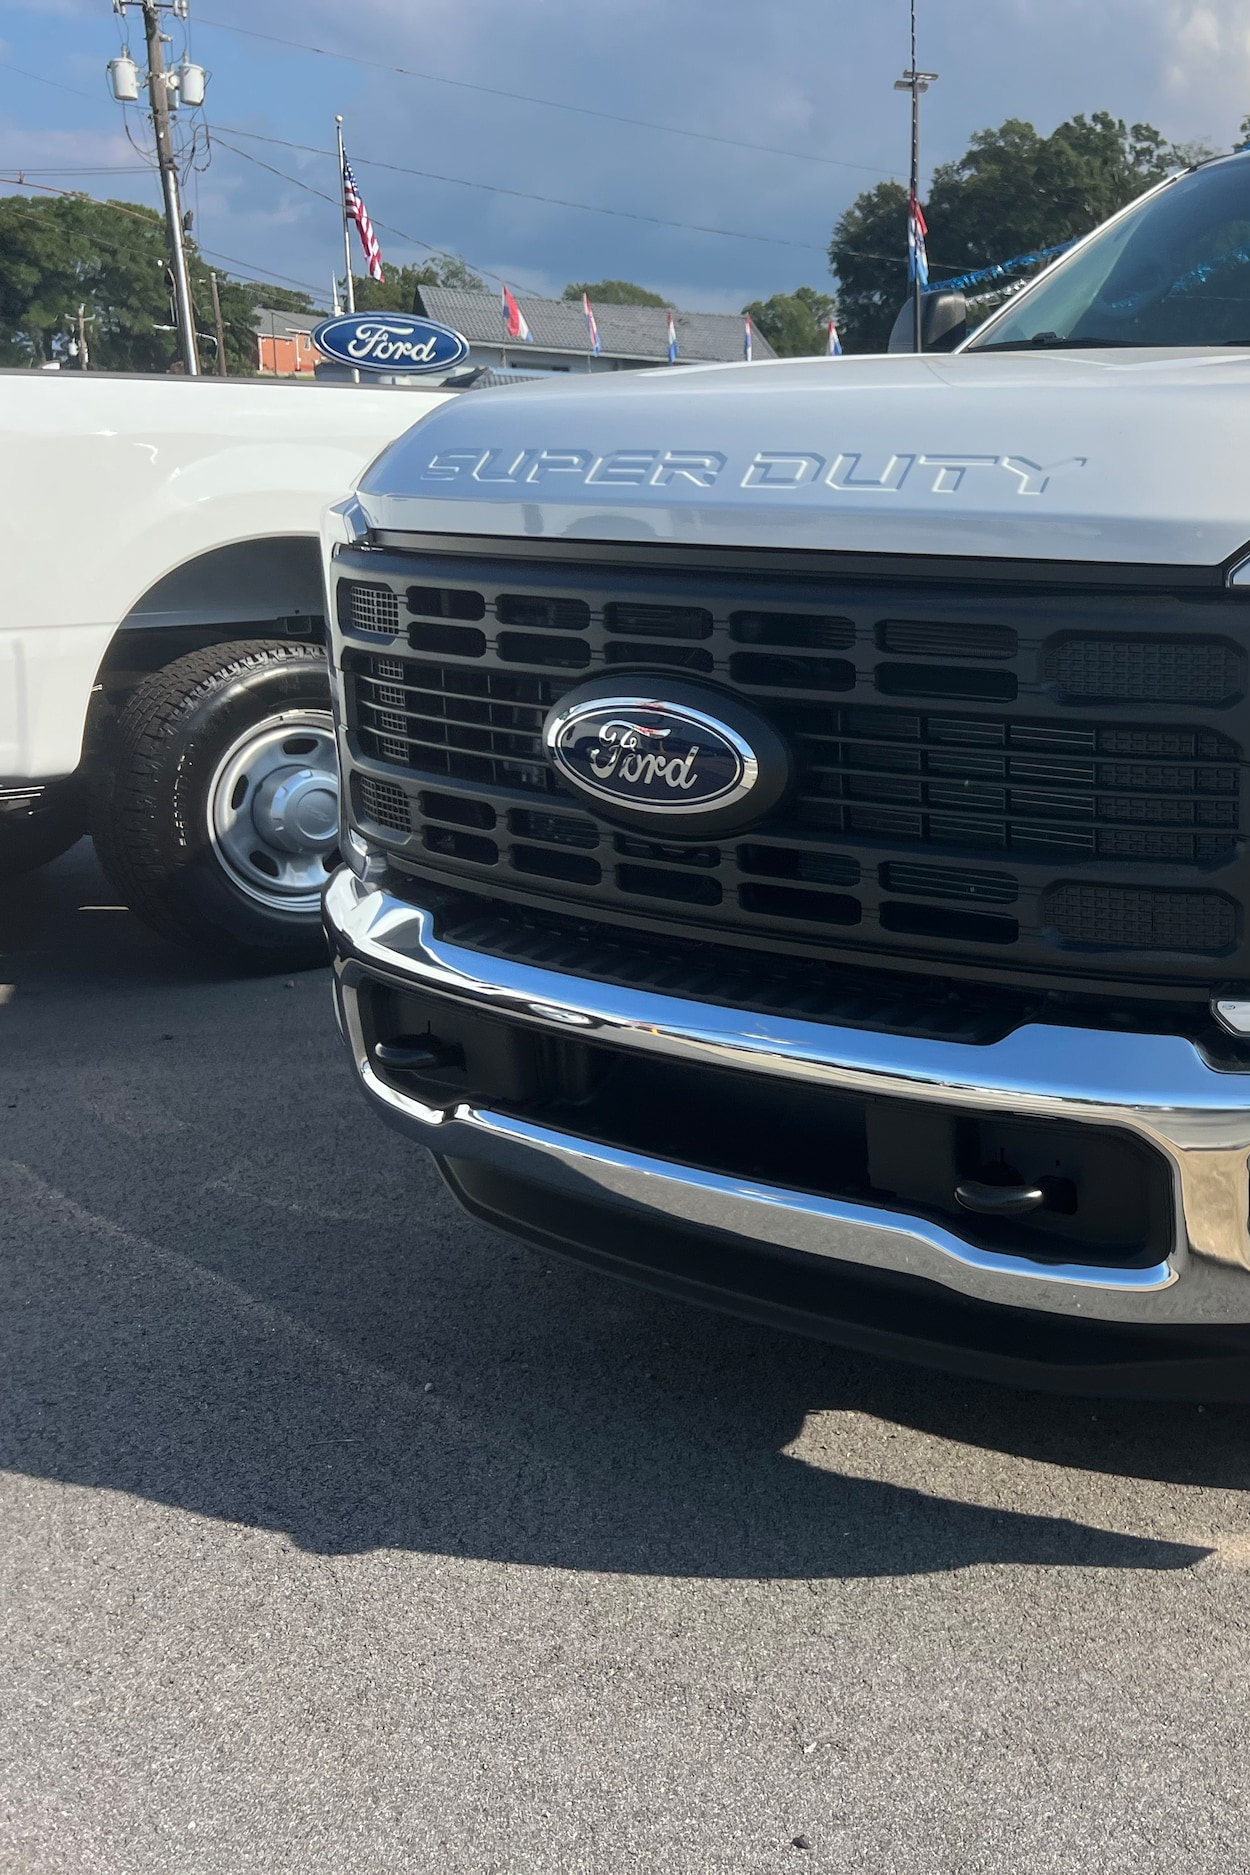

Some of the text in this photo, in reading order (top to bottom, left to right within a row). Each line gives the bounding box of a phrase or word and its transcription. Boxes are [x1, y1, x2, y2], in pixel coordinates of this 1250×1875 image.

[347, 323, 437, 362] Ford
[420, 448, 1087, 495] SUPER DUTY
[590, 719, 700, 790] Ford
